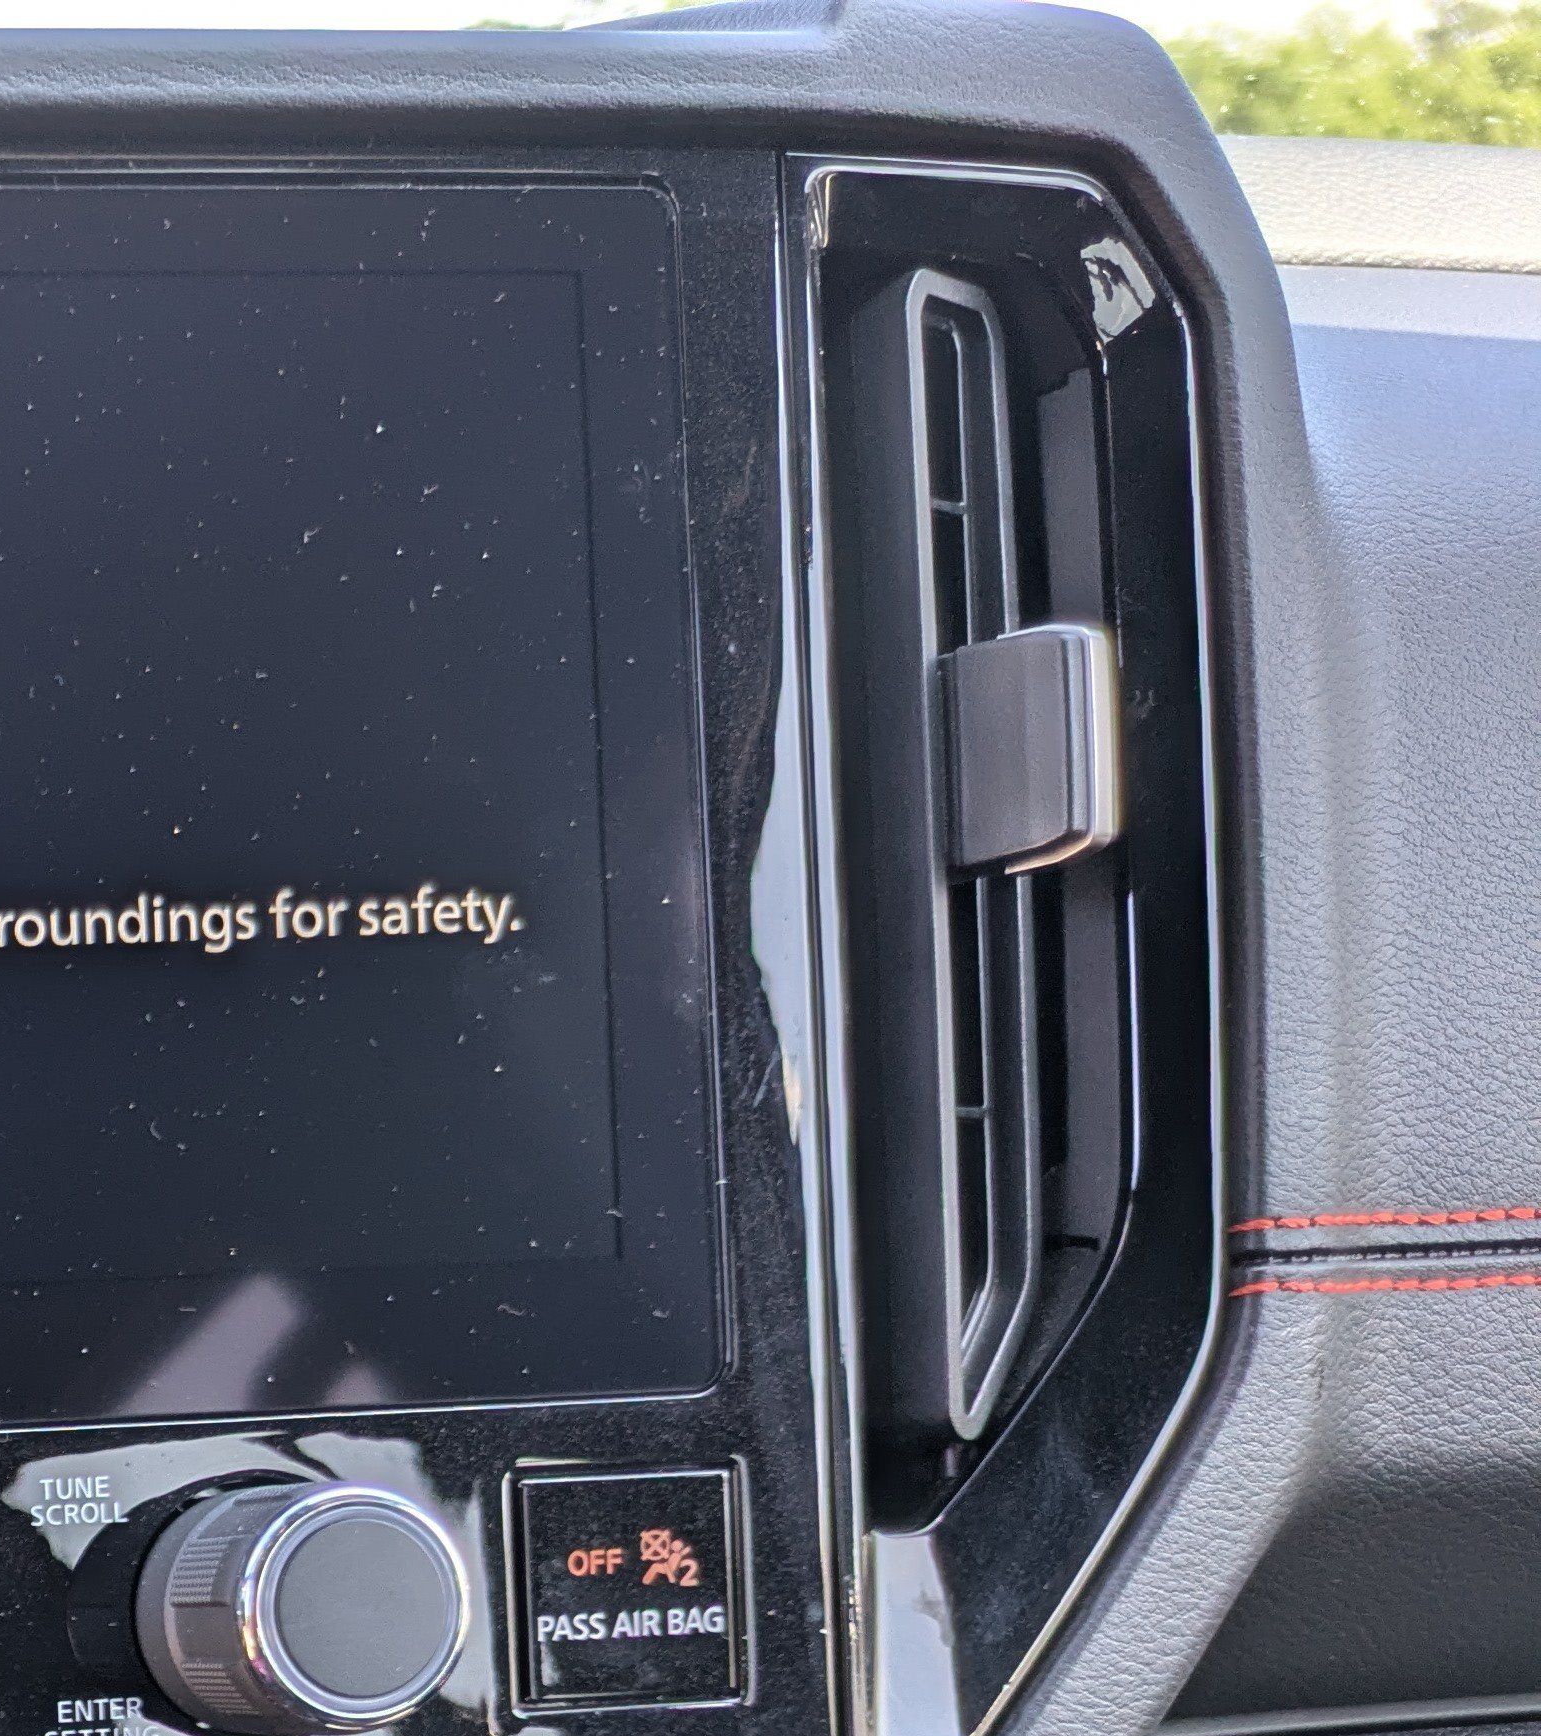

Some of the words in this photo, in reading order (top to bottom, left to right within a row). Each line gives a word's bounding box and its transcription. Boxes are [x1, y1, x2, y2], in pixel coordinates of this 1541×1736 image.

[268, 889, 344, 938] for
[358, 883, 523, 944] safety.
[39, 1475, 110, 1501] TUNE
[30, 1502, 130, 1527] SCROLL
[567, 1547, 625, 1577] OFF
[537, 1613, 607, 1642] PASS
[611, 1608, 663, 1639] AIR
[667, 1604, 727, 1635] BAG
[57, 1696, 143, 1724] ENTER
